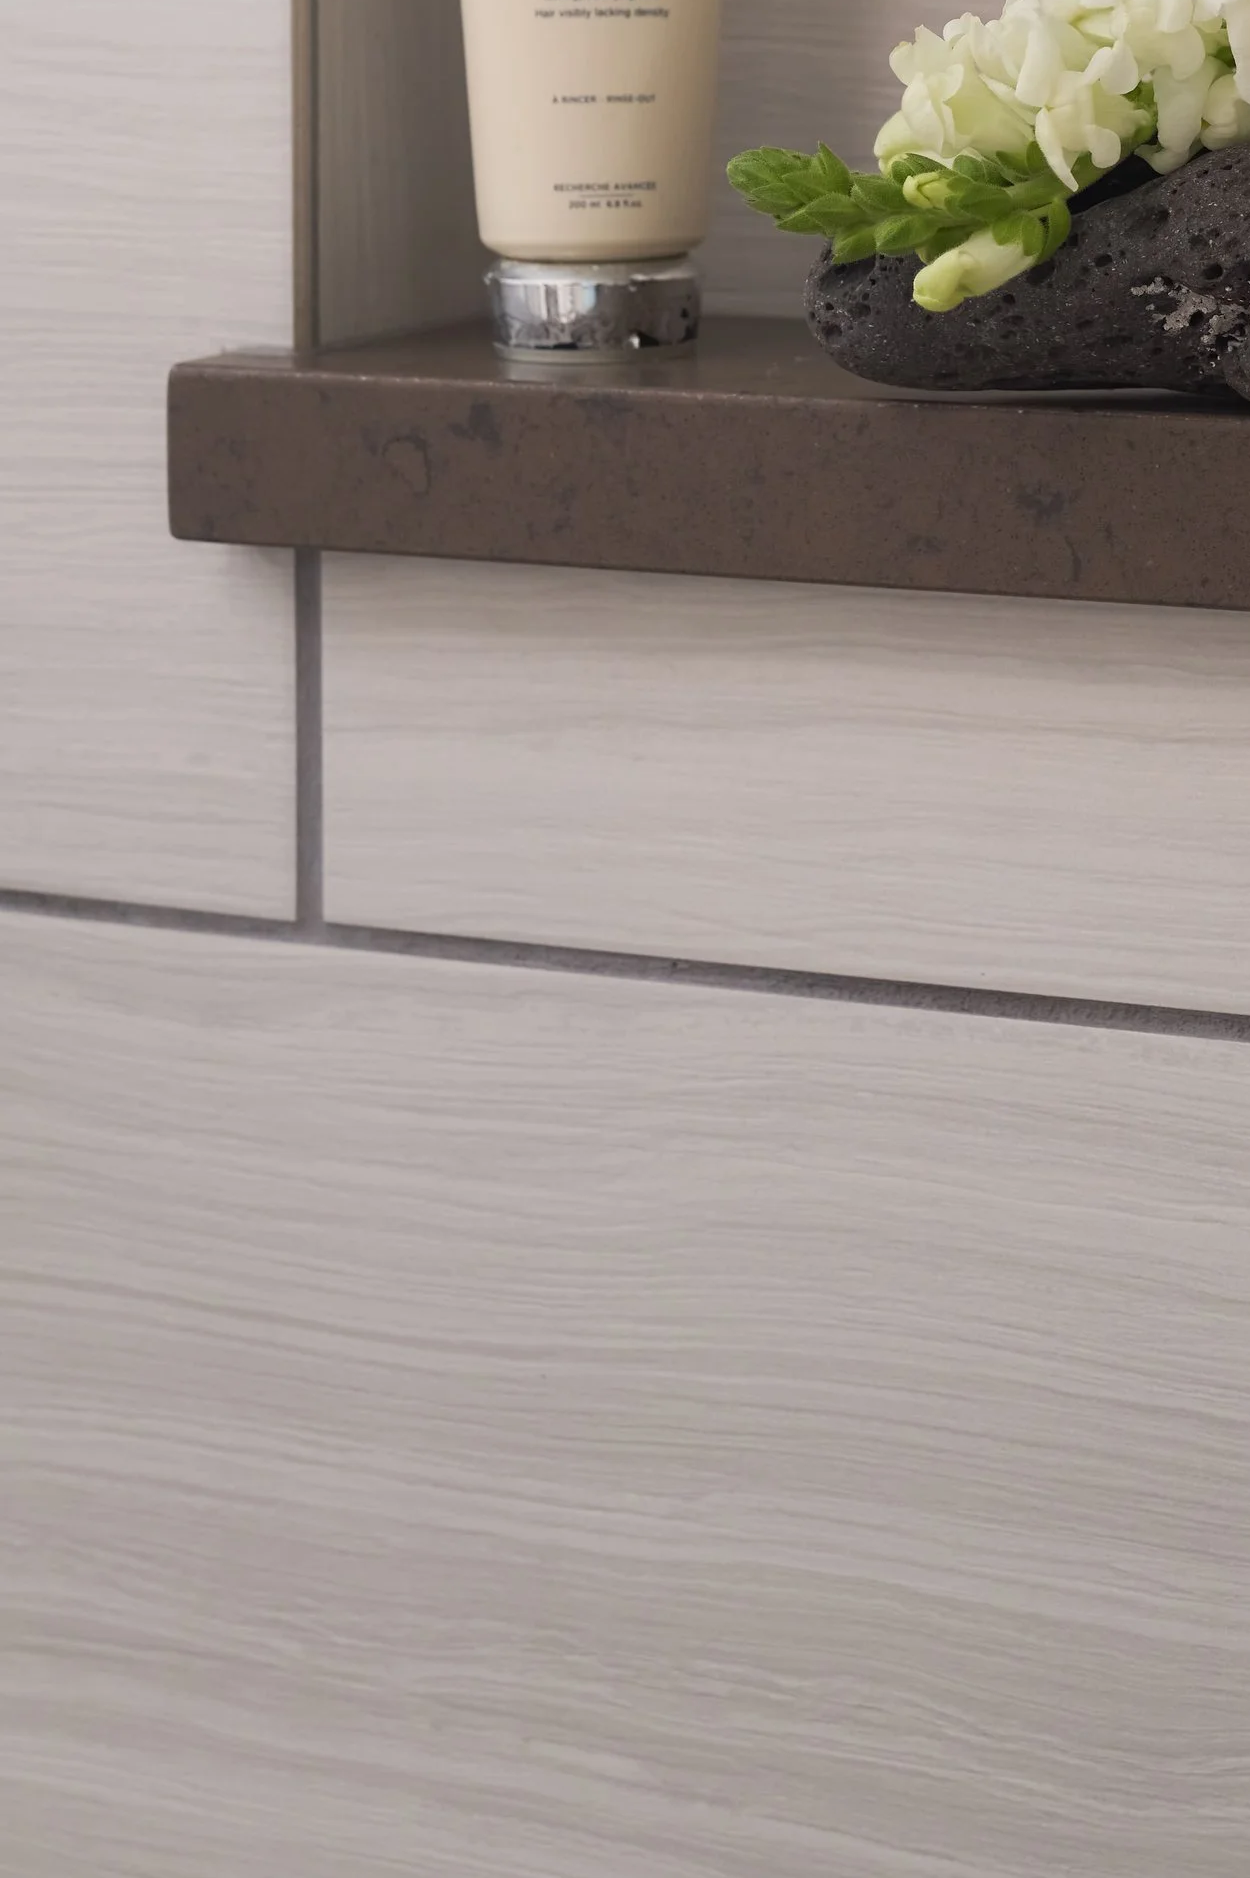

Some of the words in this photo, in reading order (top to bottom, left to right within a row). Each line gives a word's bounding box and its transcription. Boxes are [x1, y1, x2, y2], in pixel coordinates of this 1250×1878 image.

[535, 8, 555, 18] Hair
[560, 8, 591, 19] visibly
[594, 8, 631, 18] lacking
[634, 7, 669, 18] density
[553, 182, 610, 192] RECHERCHE
